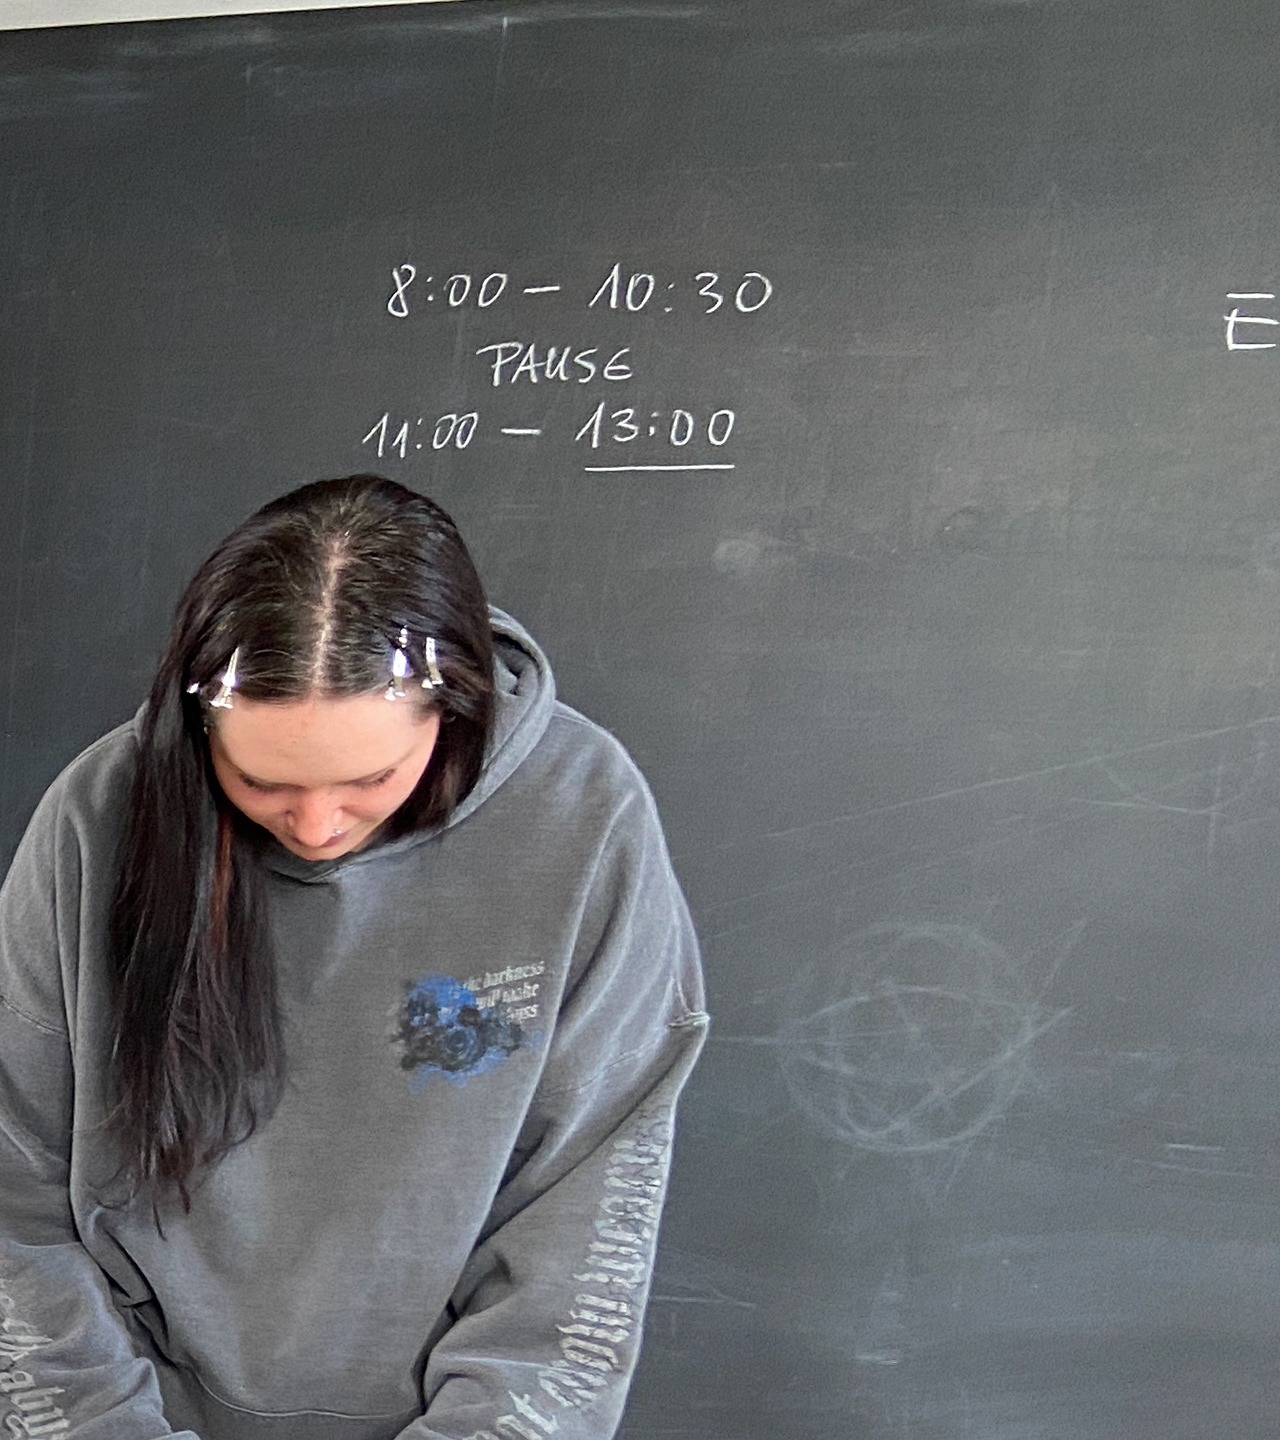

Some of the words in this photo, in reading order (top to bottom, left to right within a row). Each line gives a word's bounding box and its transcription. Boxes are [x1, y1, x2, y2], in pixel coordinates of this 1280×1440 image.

[388, 263, 508, 318] 8:00
[589, 262, 774, 314] 10:30
[476, 340, 634, 388] PAUSE
[361, 410, 479, 459] 11:00
[575, 400, 736, 449] 13:00
